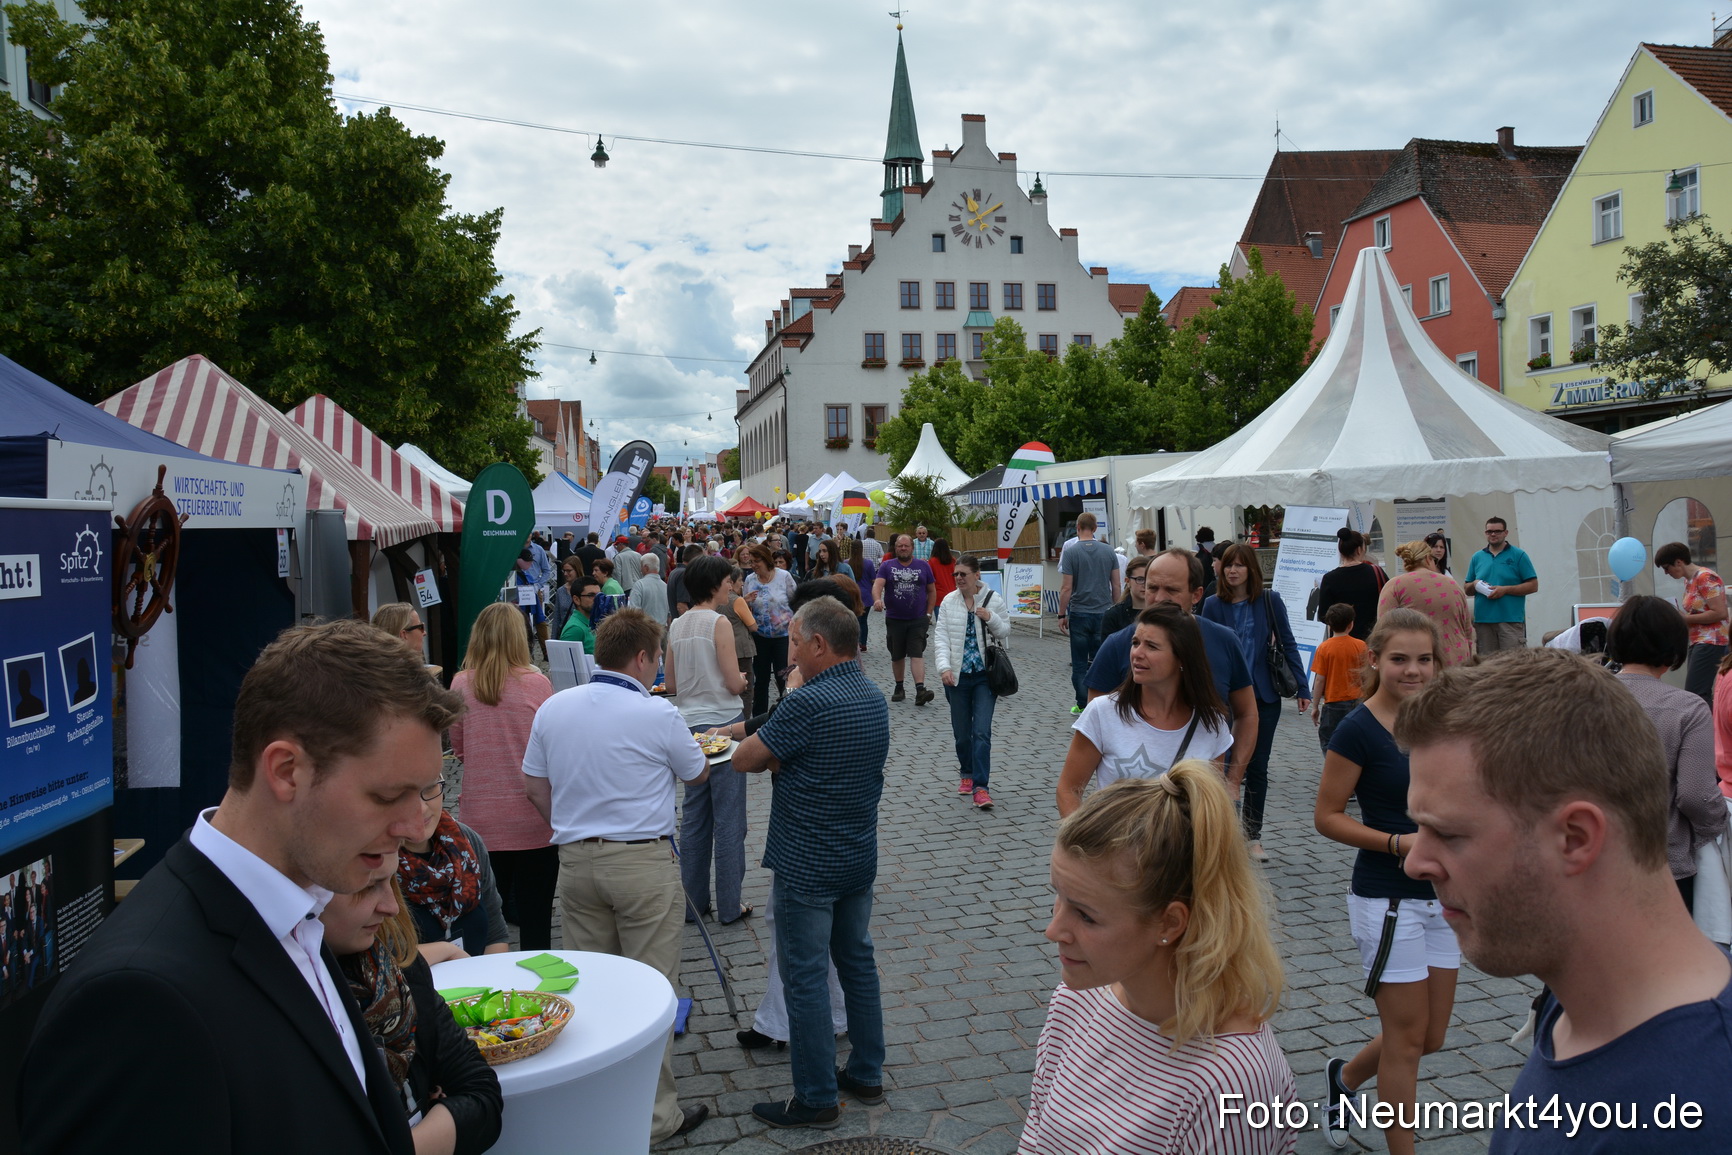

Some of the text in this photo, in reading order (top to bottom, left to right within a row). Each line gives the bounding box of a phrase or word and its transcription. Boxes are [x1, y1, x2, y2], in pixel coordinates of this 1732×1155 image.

[1551, 378, 1688, 406] ZIMMERM
[1564, 377, 1604, 389] EISENWAREN
[174, 476, 245, 498] WIRTSCHAFTS- UND
[176, 498, 242, 517] STEUERBERATUNG
[485, 489, 512, 525] D
[597, 478, 625, 538] SPANGLER
[1003, 473, 1028, 542] LNGOS
[60, 552, 89, 573] Spitz
[1280, 558, 1316, 567] Assistent/in des
[420, 589, 433, 603] 54
[6, 724, 56, 749] Bilanzbuchhalter
[26, 743, 41, 755] (m/w)
[9, 786, 48, 807] Hinweise
[47, 779, 65, 793] bitte
[65, 771, 89, 786] unter:
